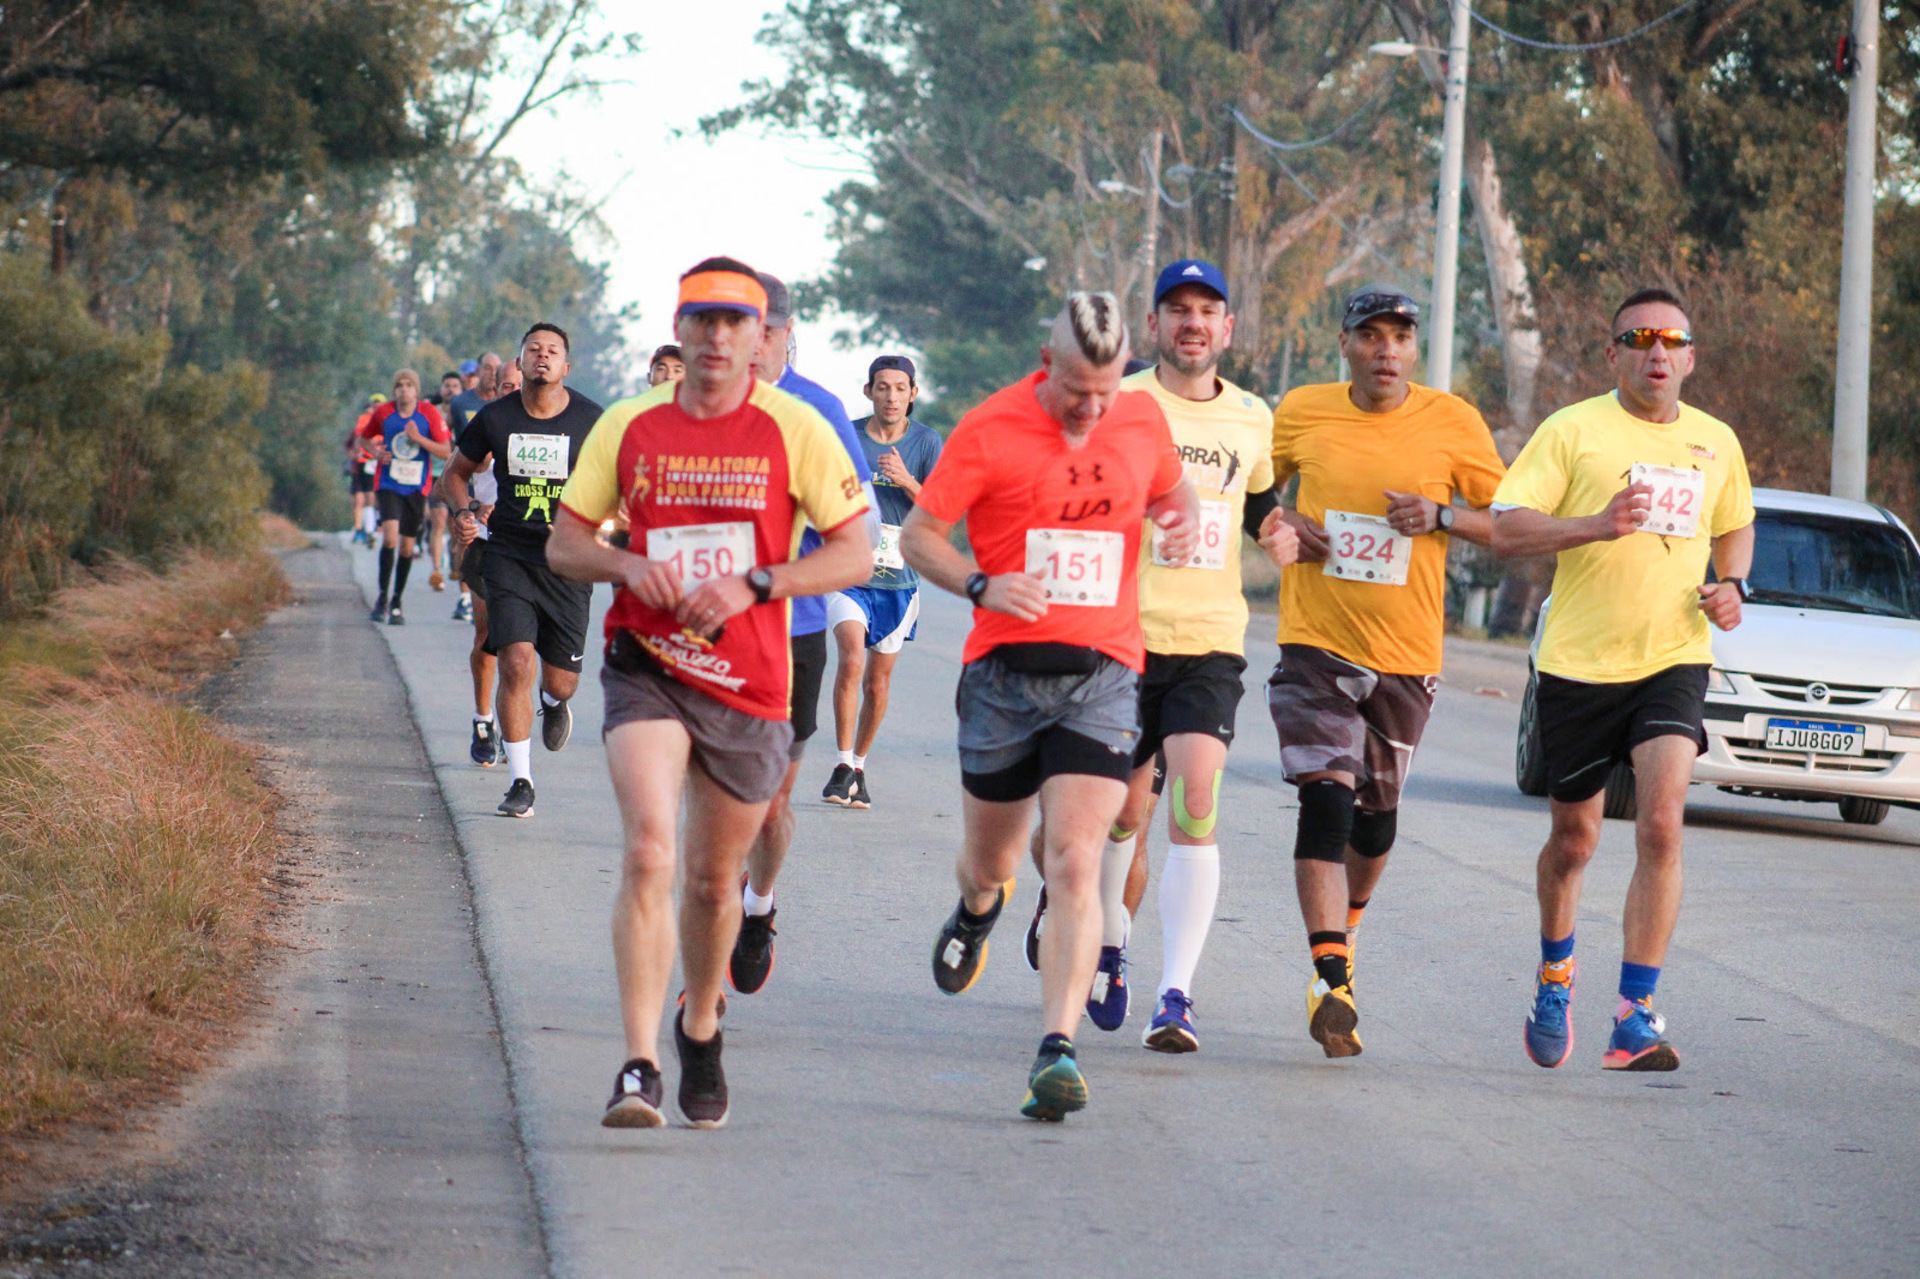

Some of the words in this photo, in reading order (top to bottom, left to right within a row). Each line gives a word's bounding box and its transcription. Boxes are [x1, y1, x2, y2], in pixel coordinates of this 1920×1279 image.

[516, 446, 559, 462] 442-1
[667, 455, 770, 475] MARATONA
[666, 472, 768, 486] INTERNACIONAL
[514, 484, 544, 498] CROSS
[546, 485, 565, 499] LIF
[666, 482, 697, 496] DOS
[701, 483, 767, 500] PAMPAS
[1337, 531, 1394, 564] 324
[670, 547, 733, 580] 150
[1046, 551, 1103, 582] 151
[1774, 728, 1854, 752] IJU8G09
